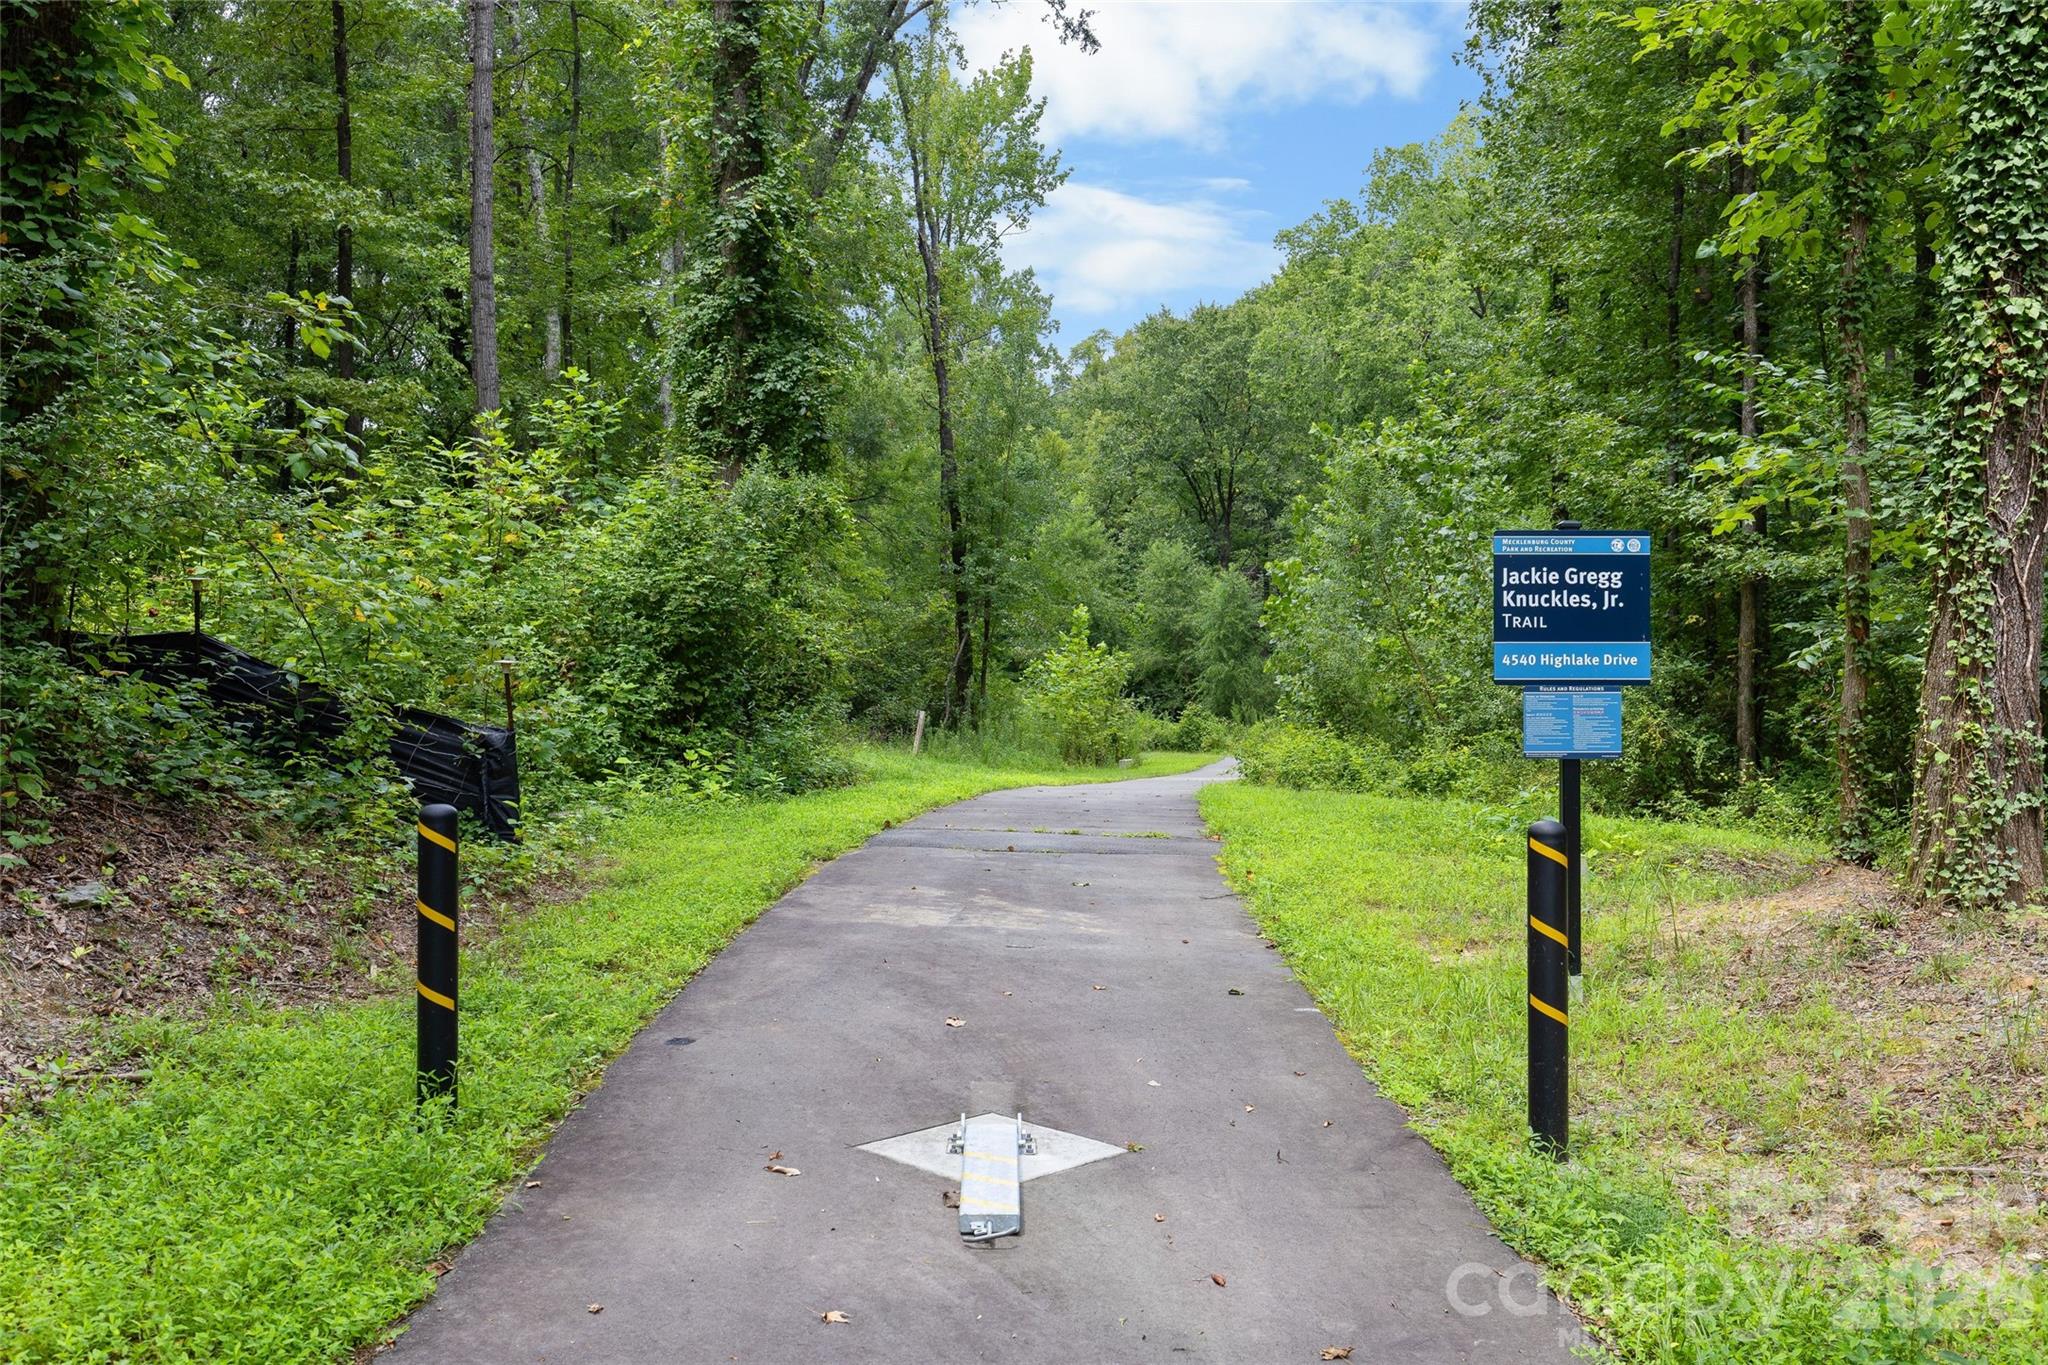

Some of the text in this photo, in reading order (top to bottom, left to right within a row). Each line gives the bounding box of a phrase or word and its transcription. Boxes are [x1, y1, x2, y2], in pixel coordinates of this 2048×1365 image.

[1501, 567, 1623, 588] Jackie Gregg
[1502, 590, 1624, 610] Knuckles, Jr.
[1502, 654, 1638, 668] 4540 Highlake Drive
